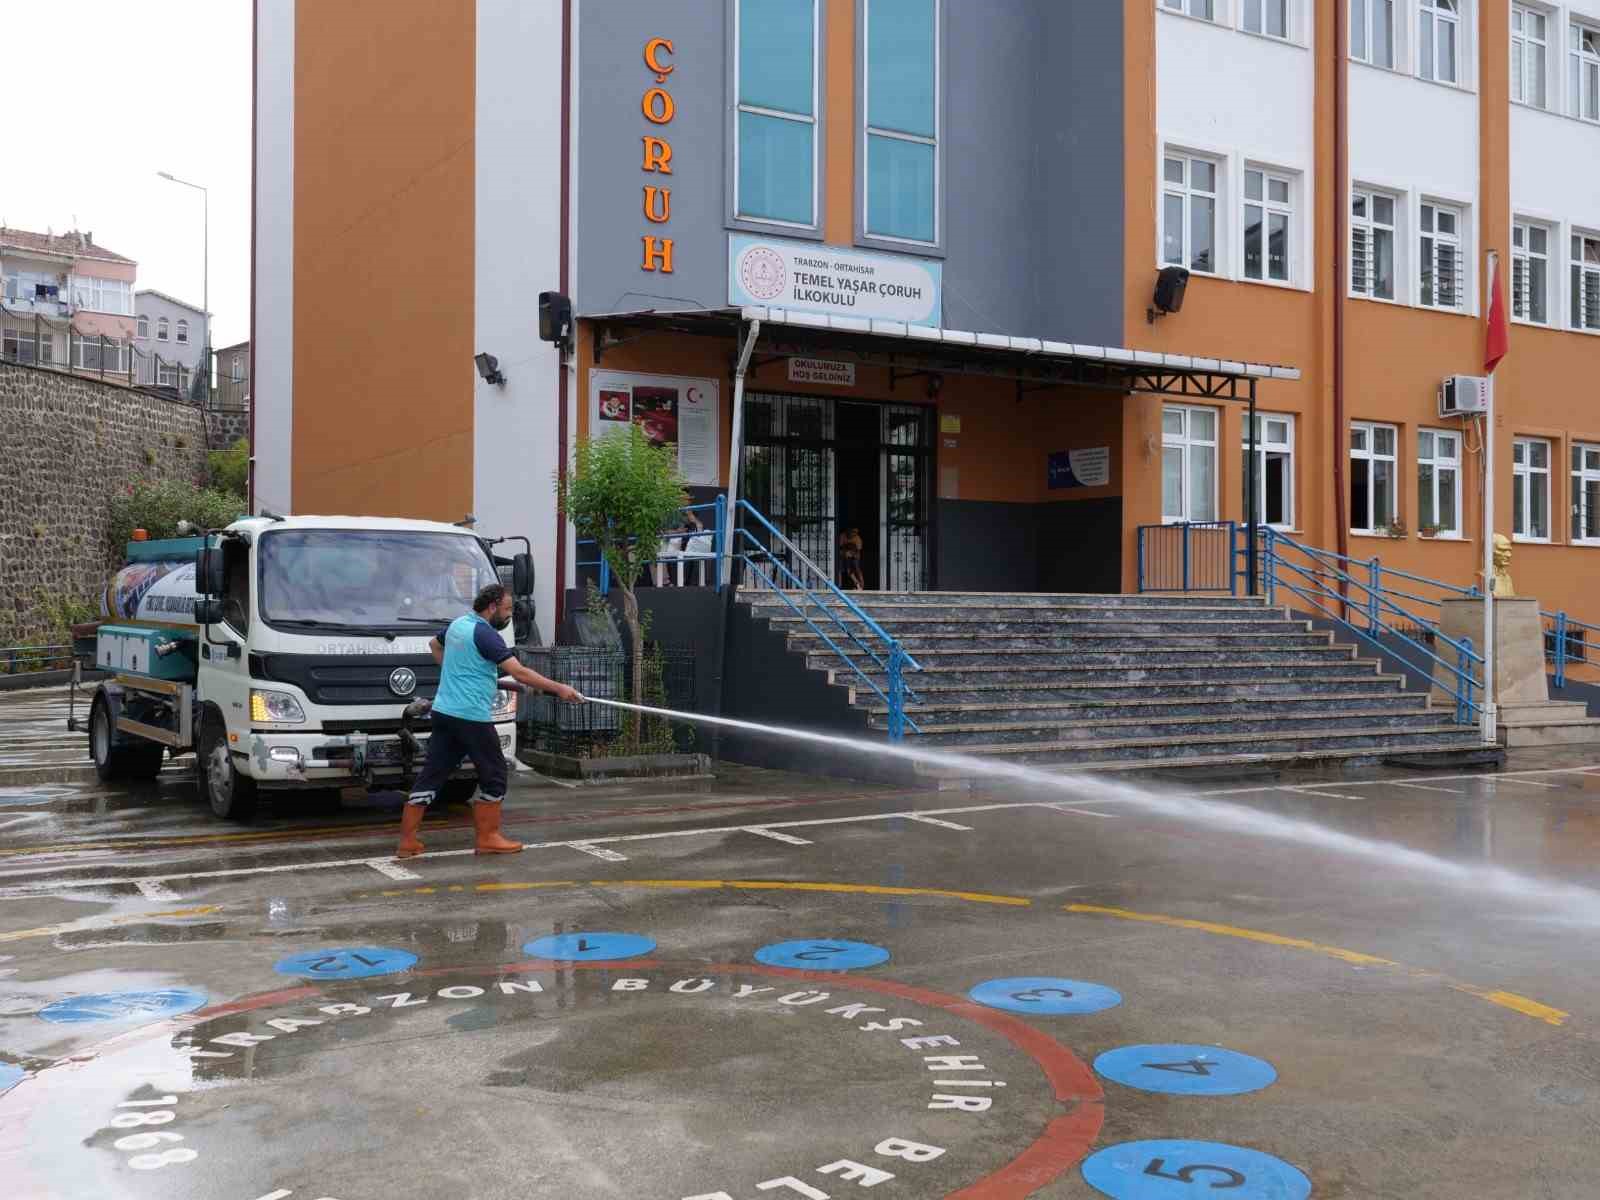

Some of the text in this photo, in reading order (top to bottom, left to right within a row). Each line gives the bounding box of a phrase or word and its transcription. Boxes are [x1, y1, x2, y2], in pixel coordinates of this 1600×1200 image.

[641, 37, 676, 275] ÇORUH
[793, 256, 829, 270] TRABZON
[834, 261, 875, 276] ORTAHİSAR
[793, 272, 922, 299] TEMEL YAŞAR ÇORUH
[793, 288, 856, 307] İLKOKULU
[794, 359, 846, 372] OKULUMUZA
[791, 943, 848, 962] 2
[300, 953, 387, 974] 12
[1008, 986, 1075, 1005] 3
[611, 977, 1006, 1113] BÜYÜKŞEHİR
[1140, 1058, 1221, 1079] 4
[1142, 1157, 1247, 1191] 5
